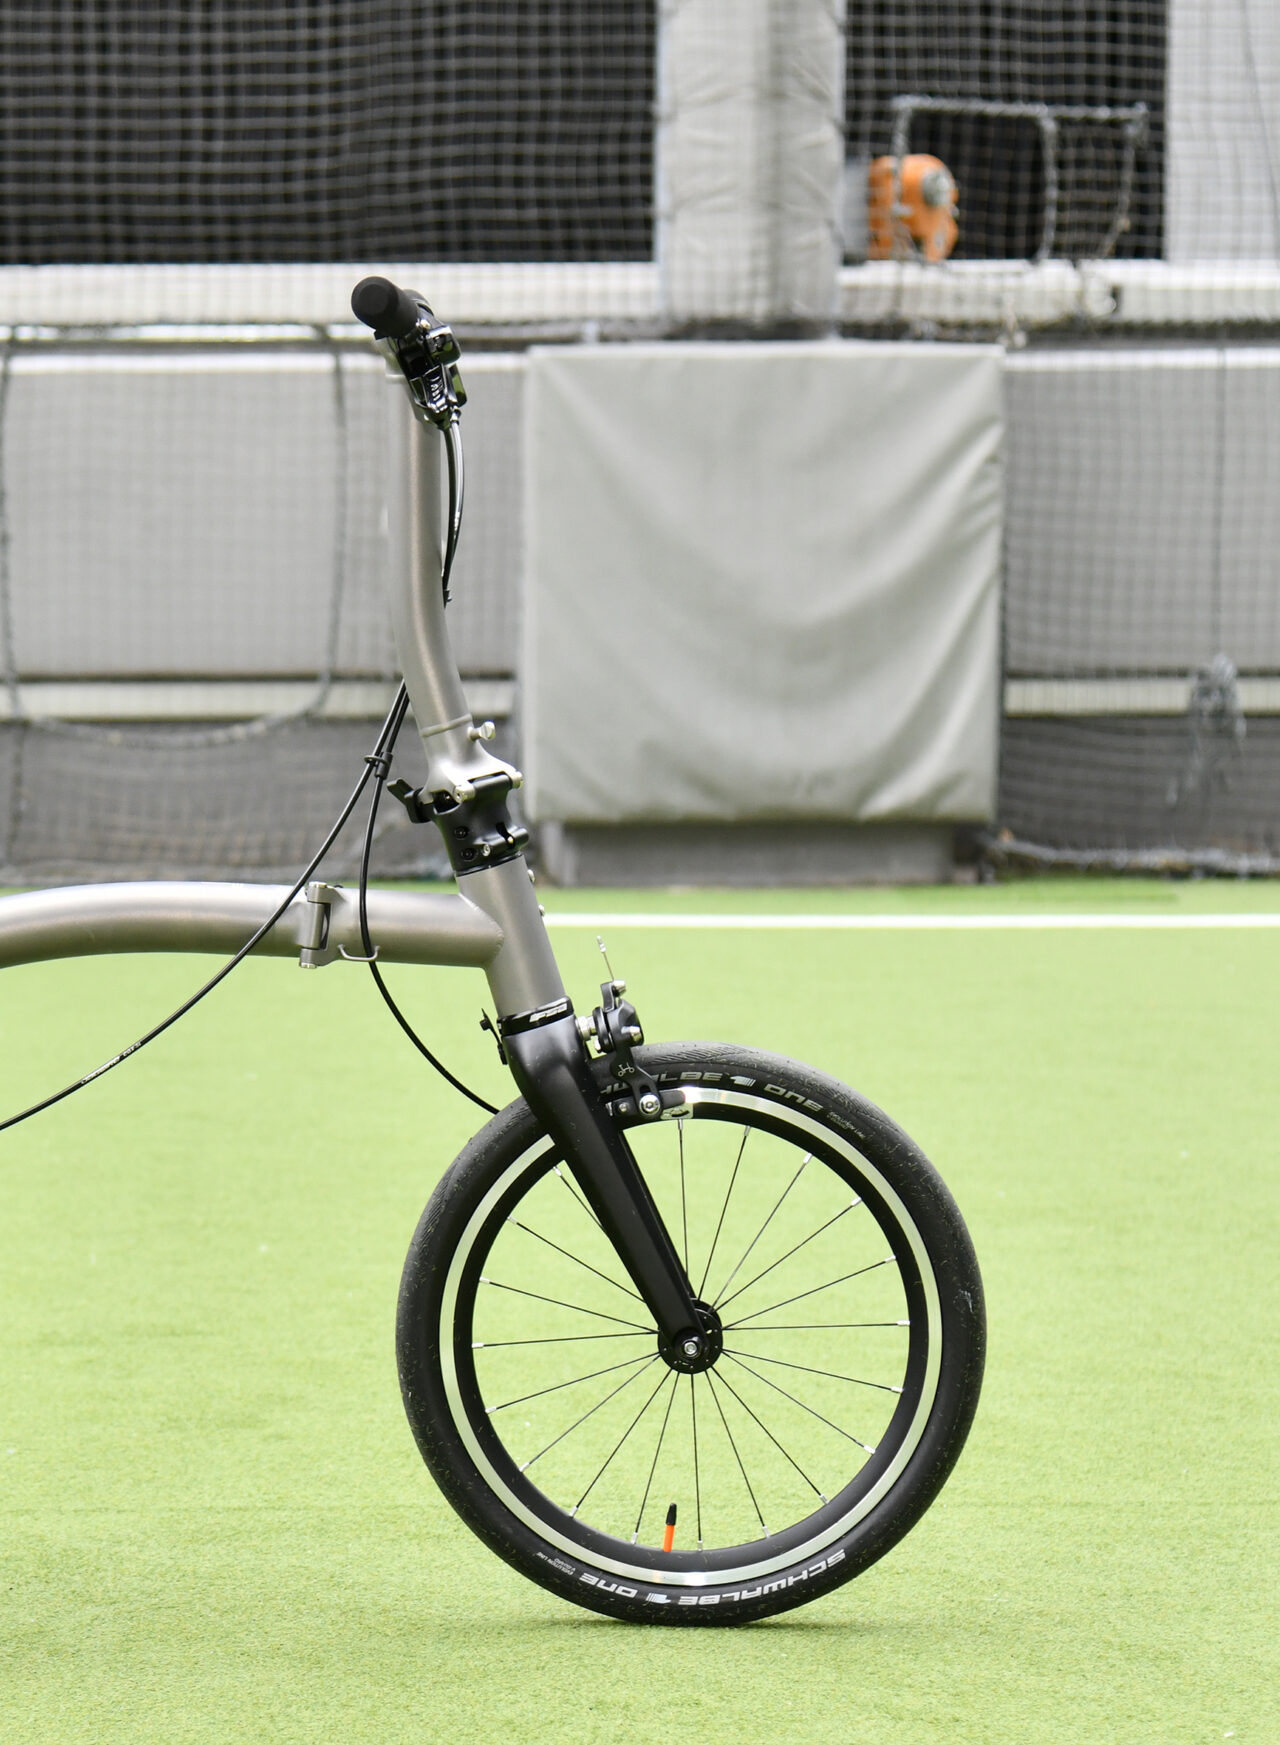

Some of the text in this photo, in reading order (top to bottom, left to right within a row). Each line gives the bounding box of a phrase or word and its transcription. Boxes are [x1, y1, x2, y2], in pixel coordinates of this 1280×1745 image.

[763, 1083, 824, 1113] ONE
[578, 1572, 639, 1599] ONE
[677, 1548, 847, 1606] SCHWALBE
